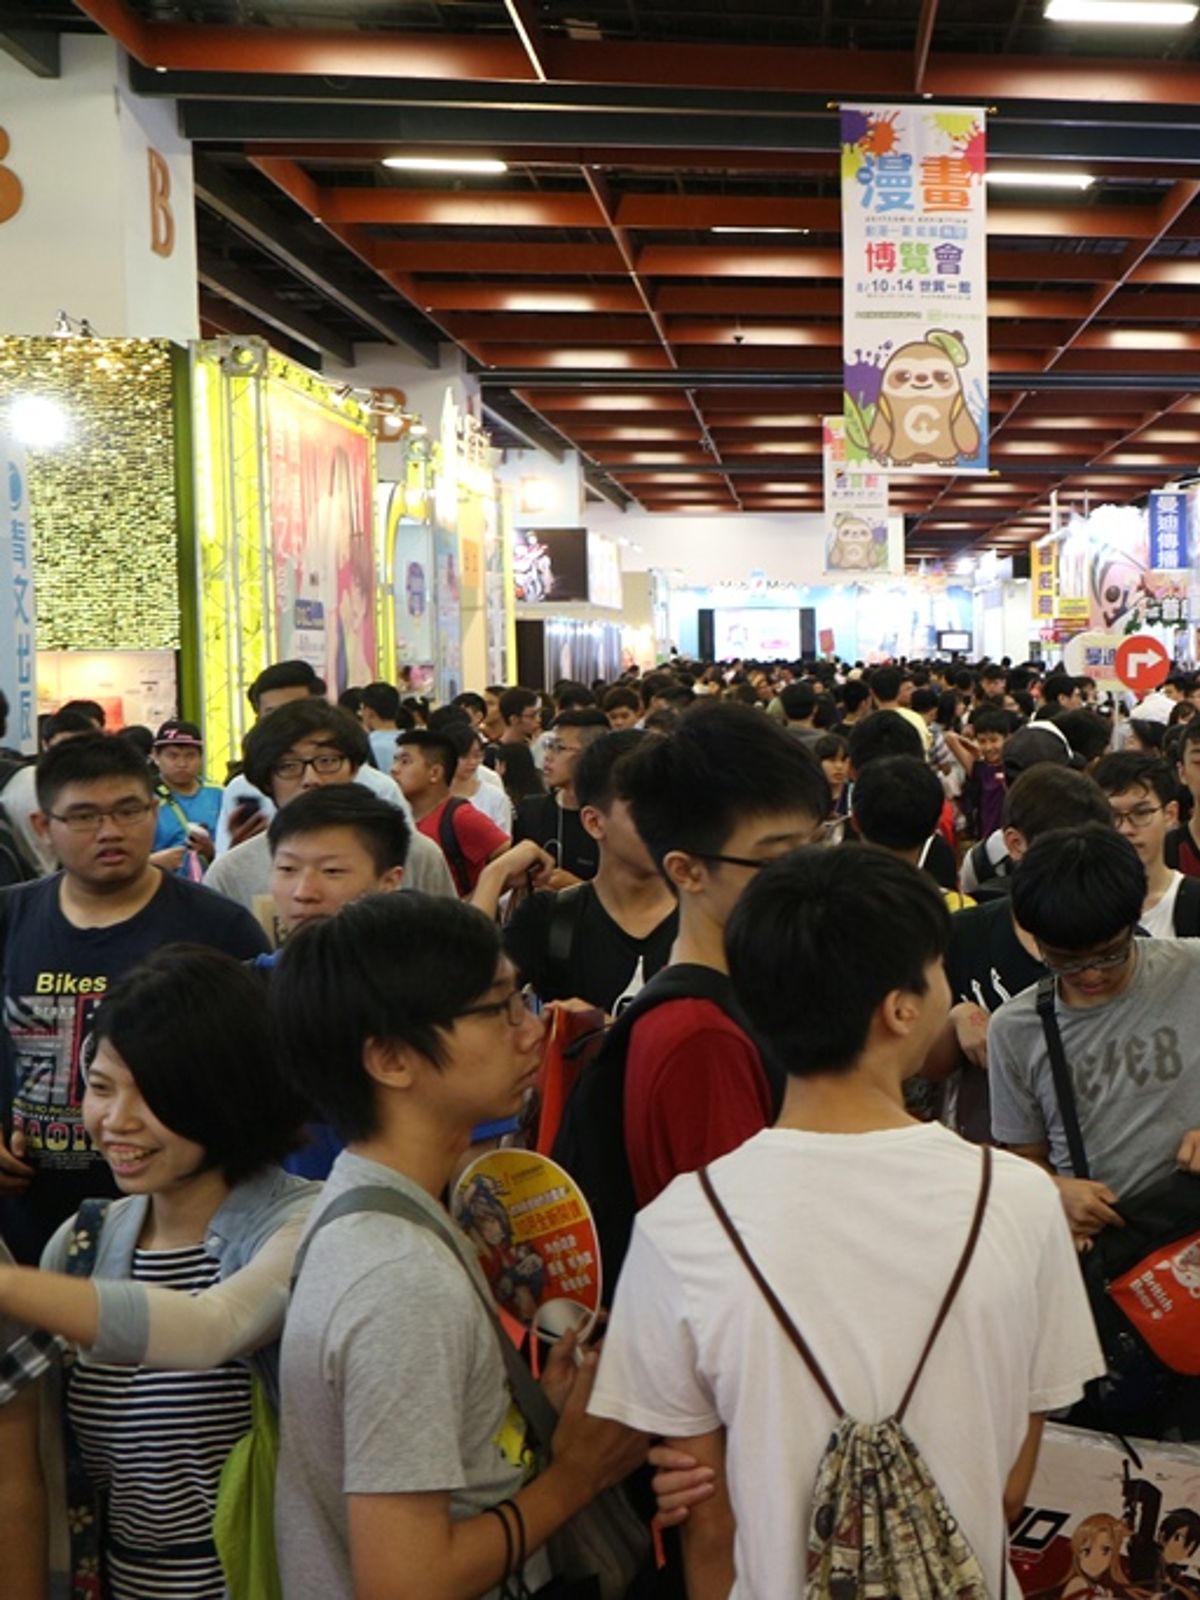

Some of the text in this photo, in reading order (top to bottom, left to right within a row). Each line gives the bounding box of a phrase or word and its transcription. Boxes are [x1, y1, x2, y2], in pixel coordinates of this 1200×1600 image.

[147, 146, 175, 259] B
[858, 153, 974, 214] 漫畫
[864, 240, 964, 275] 博覽會
[36, 972, 107, 994] Bikes
